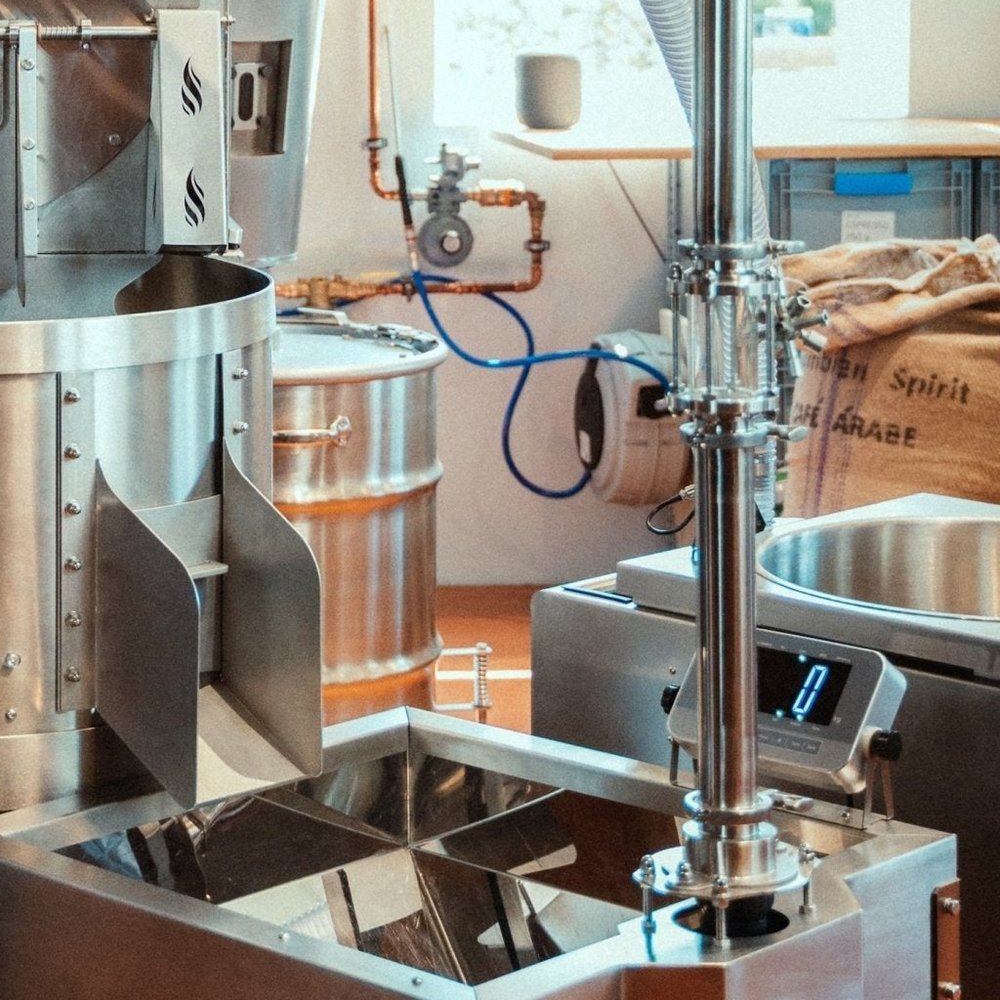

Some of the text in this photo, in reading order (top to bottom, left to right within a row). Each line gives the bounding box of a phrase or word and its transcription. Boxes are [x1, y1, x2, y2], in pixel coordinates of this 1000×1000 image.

[889, 367, 970, 404] Spirit
[832, 405, 917, 448] ÁRABE
[792, 664, 828, 713] 0
